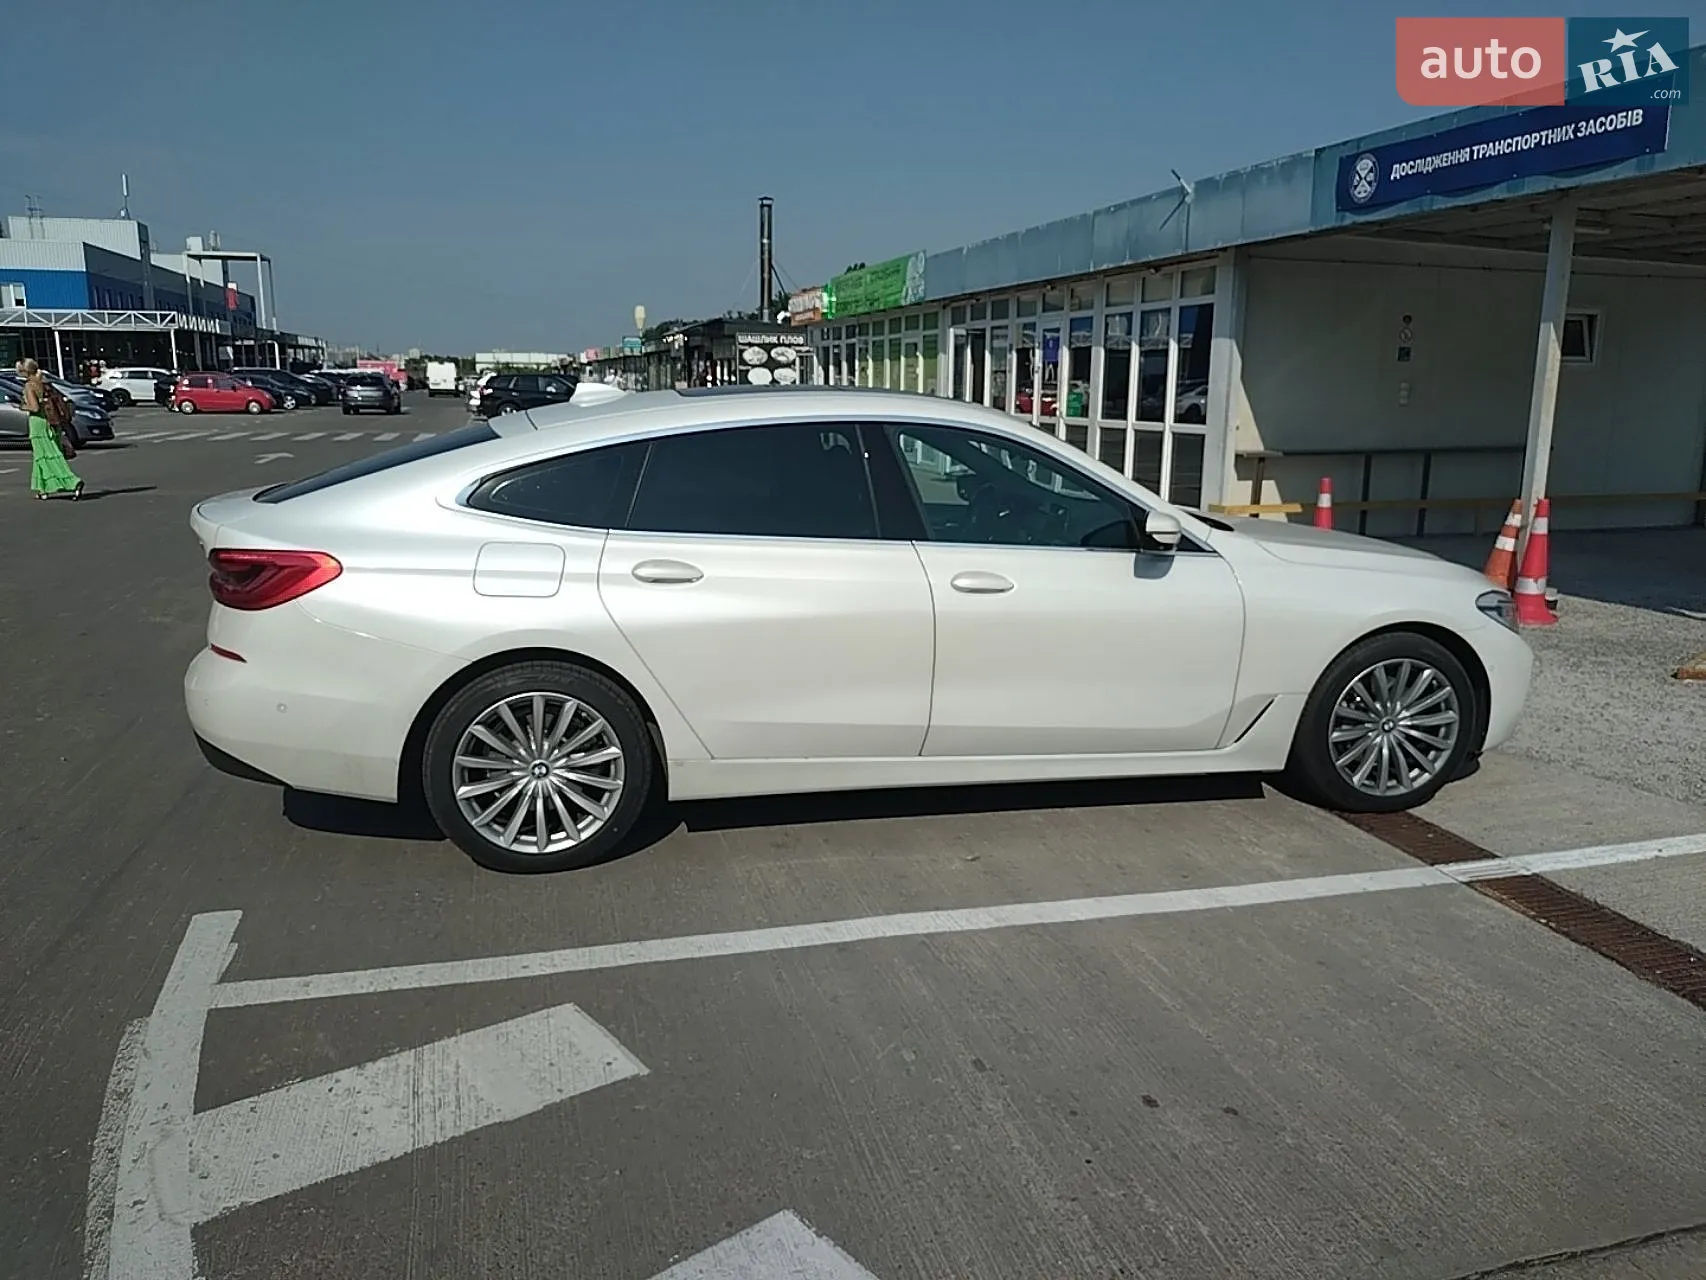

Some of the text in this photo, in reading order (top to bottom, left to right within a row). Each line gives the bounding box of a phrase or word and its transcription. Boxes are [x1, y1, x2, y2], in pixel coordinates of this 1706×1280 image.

[1390, 108, 1644, 180] ДОСЛІДЖЕННЯ ТРАНСПОРТНИХ ЗАСОБІВ
